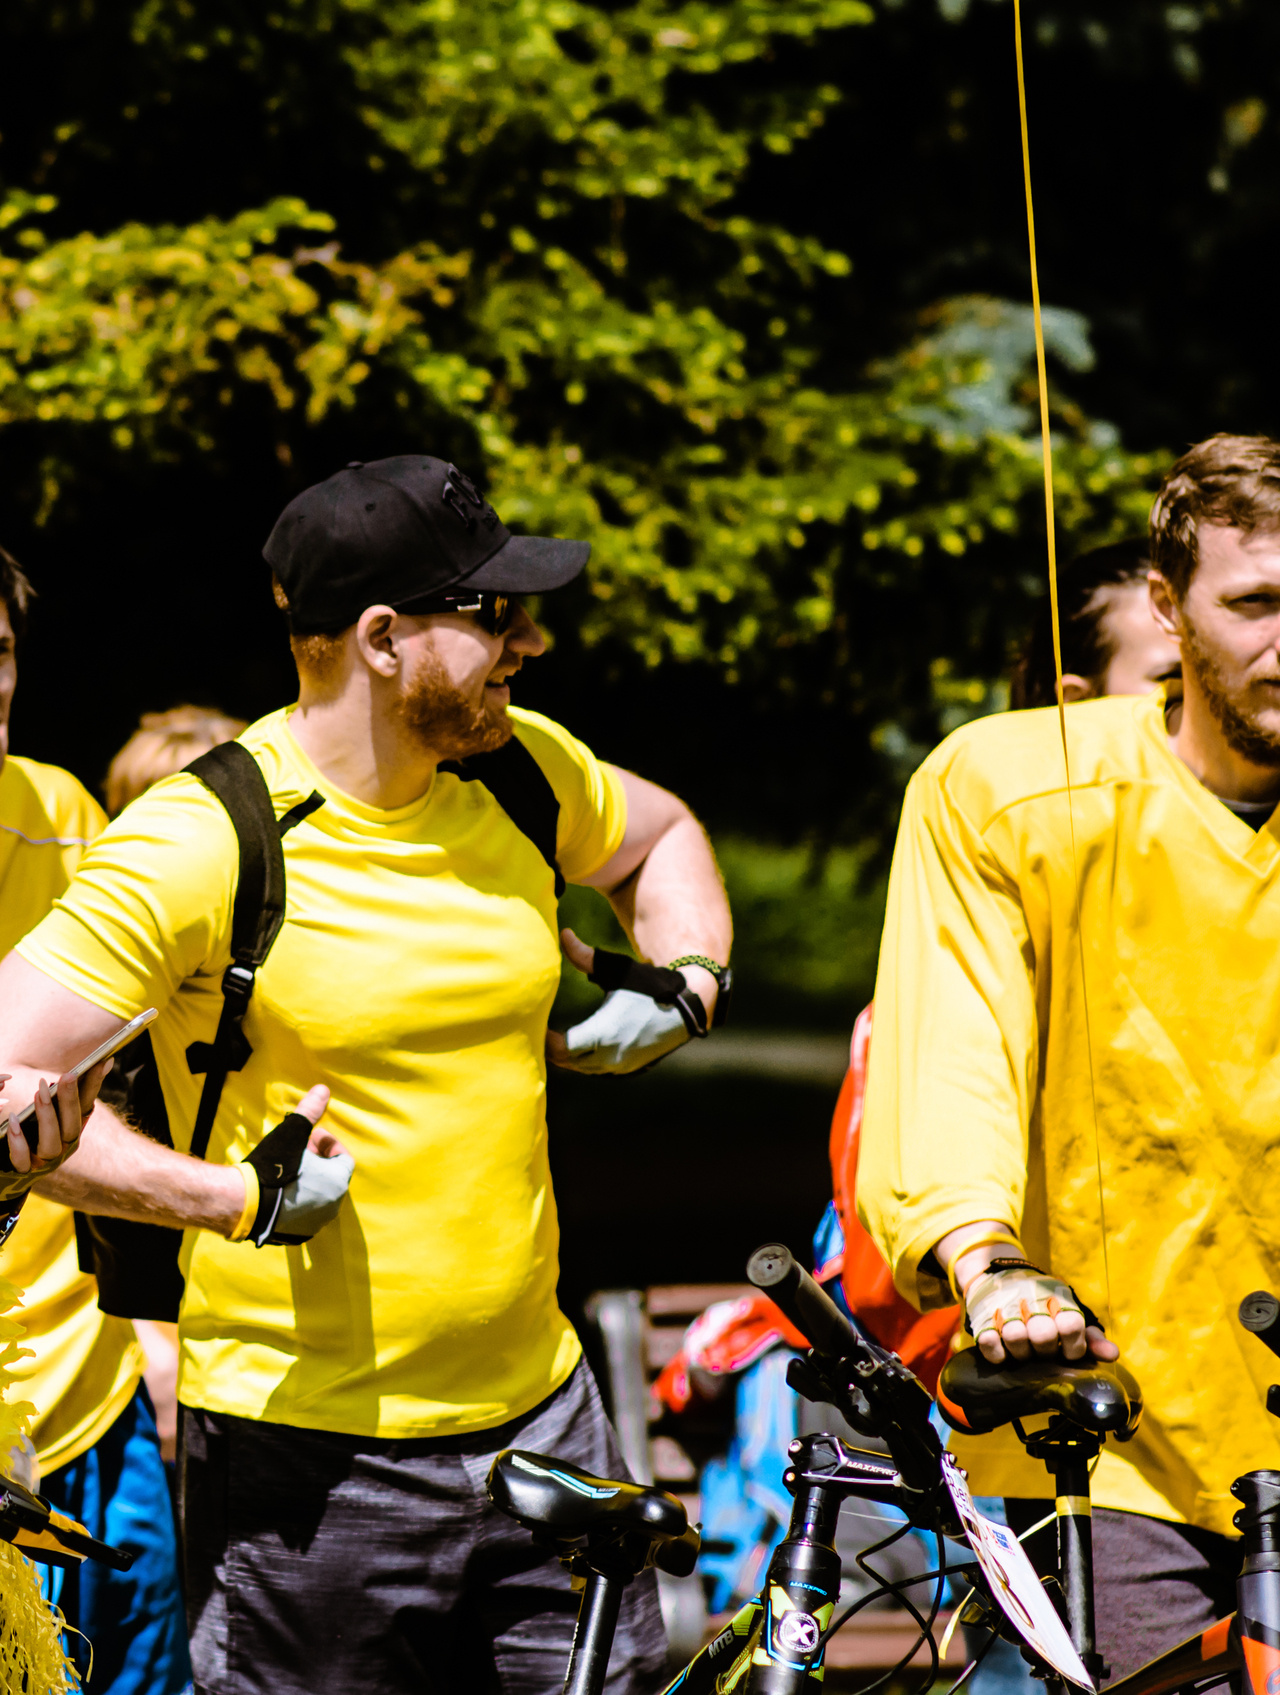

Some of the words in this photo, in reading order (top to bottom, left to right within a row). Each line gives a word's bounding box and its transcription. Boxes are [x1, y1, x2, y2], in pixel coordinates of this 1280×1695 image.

[846, 1460, 898, 1477] MAXXPRO
[788, 1580, 829, 1597] MAXXPRO
[708, 1629, 734, 1659] MTB
